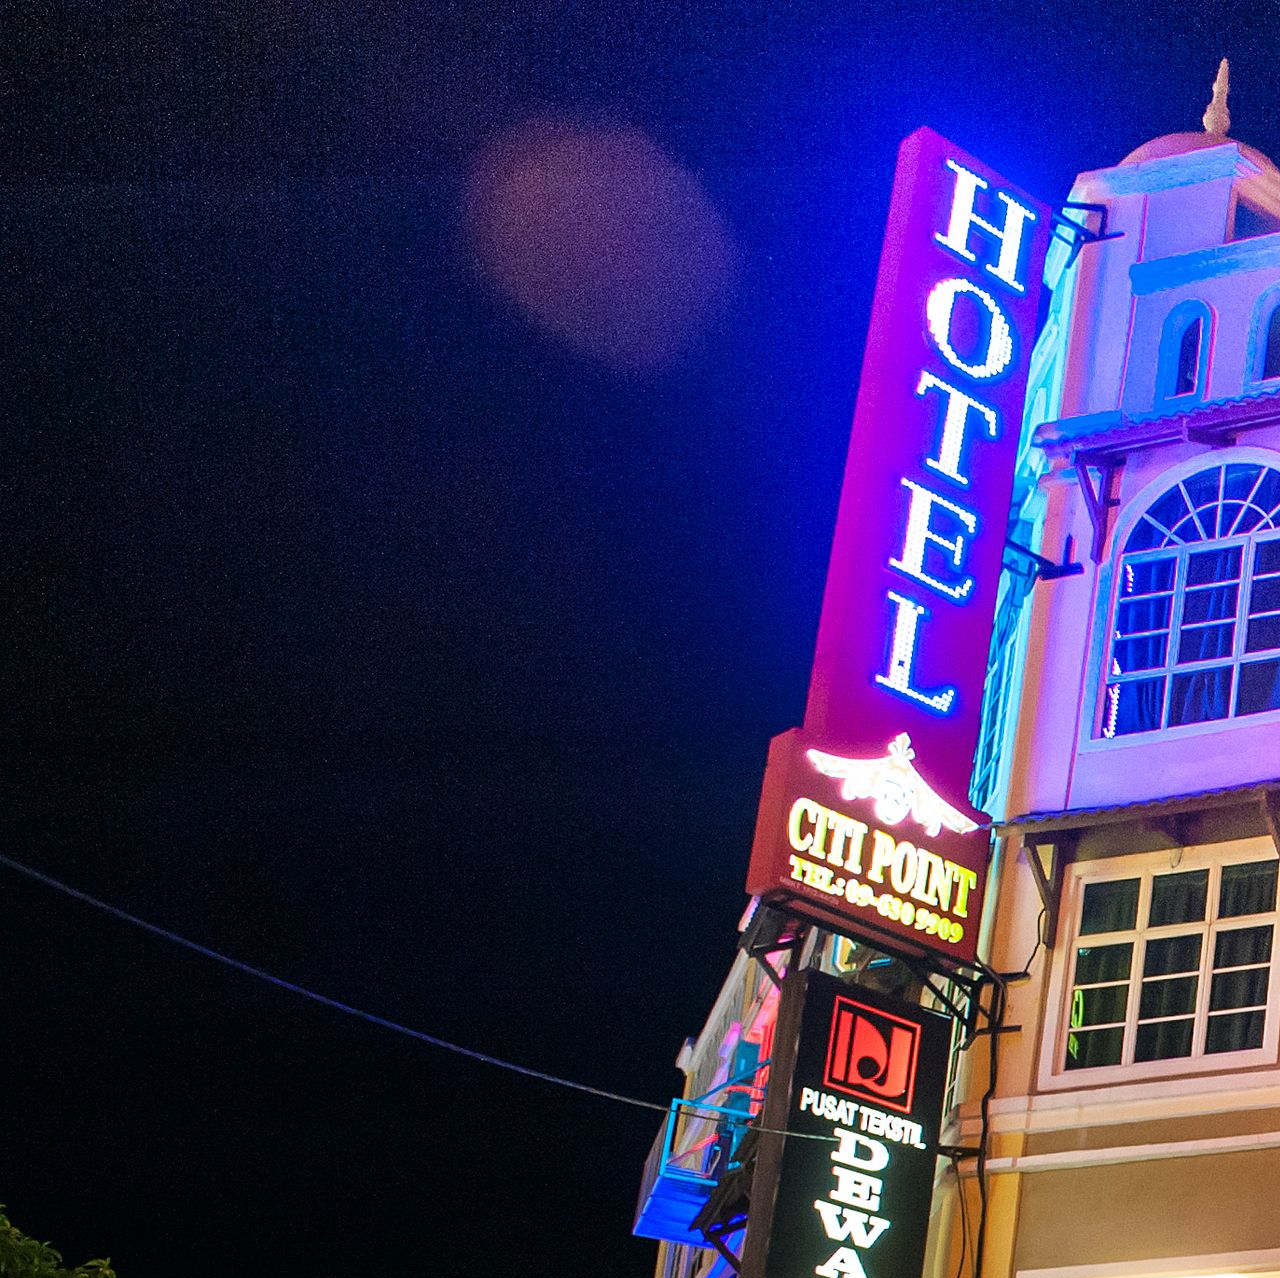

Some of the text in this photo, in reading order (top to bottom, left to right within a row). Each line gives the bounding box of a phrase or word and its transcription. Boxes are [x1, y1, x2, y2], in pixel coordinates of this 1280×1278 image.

[874, 158, 1036, 714] HOTEL
[788, 797, 978, 918] CITI POINT
[800, 1086, 927, 1150] PUSAT TEKSTIL
